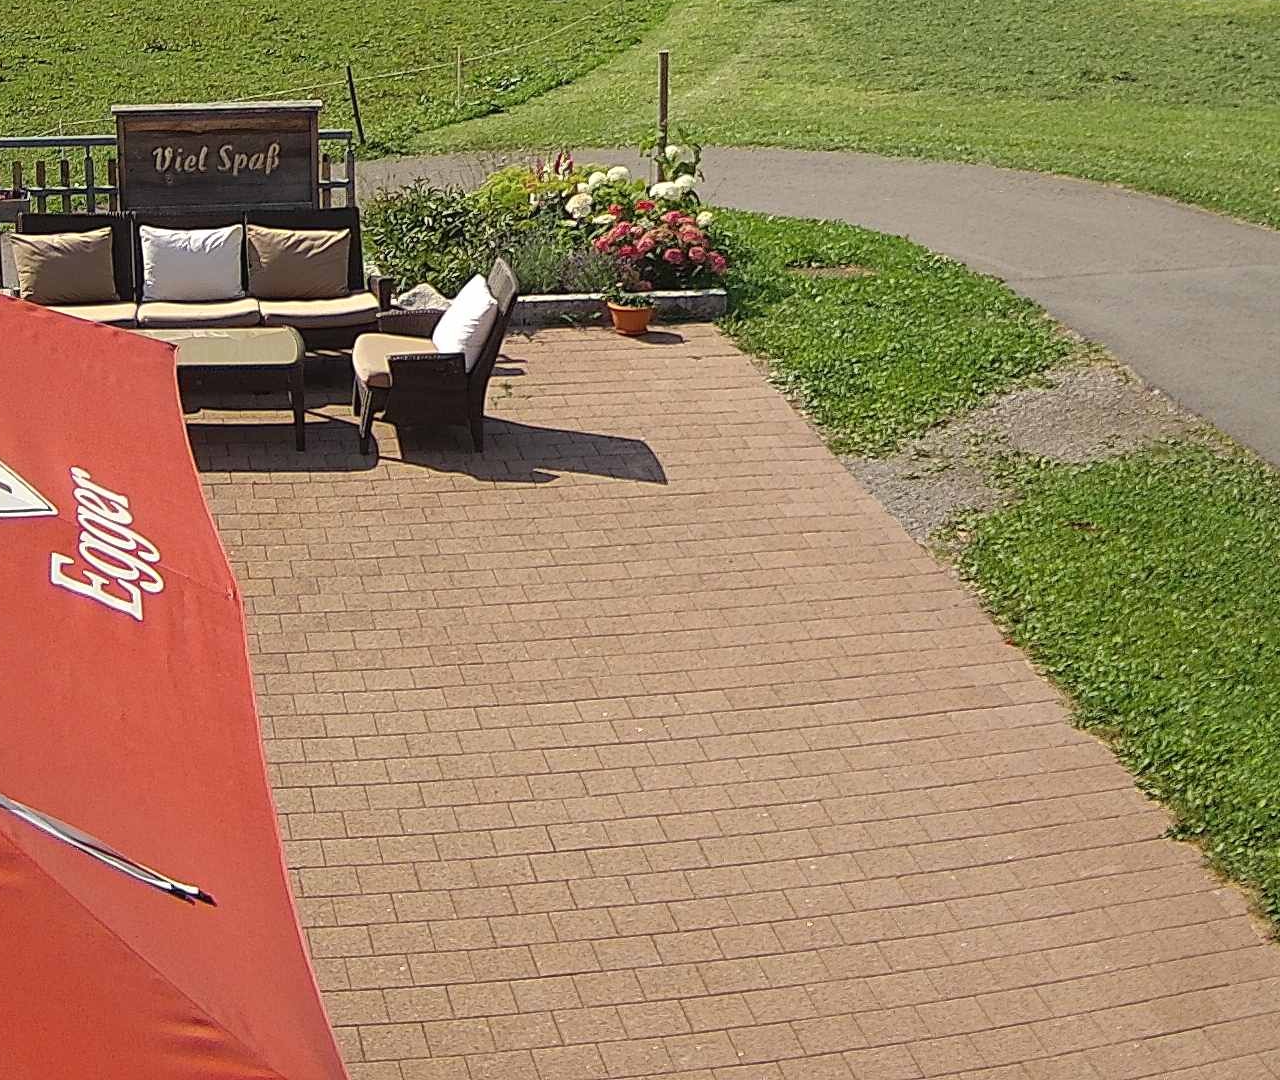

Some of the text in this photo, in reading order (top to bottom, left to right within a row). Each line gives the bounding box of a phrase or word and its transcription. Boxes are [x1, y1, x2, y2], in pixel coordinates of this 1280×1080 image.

[153, 141, 280, 176] Viel Spaß
[50, 466, 165, 621] Egger
